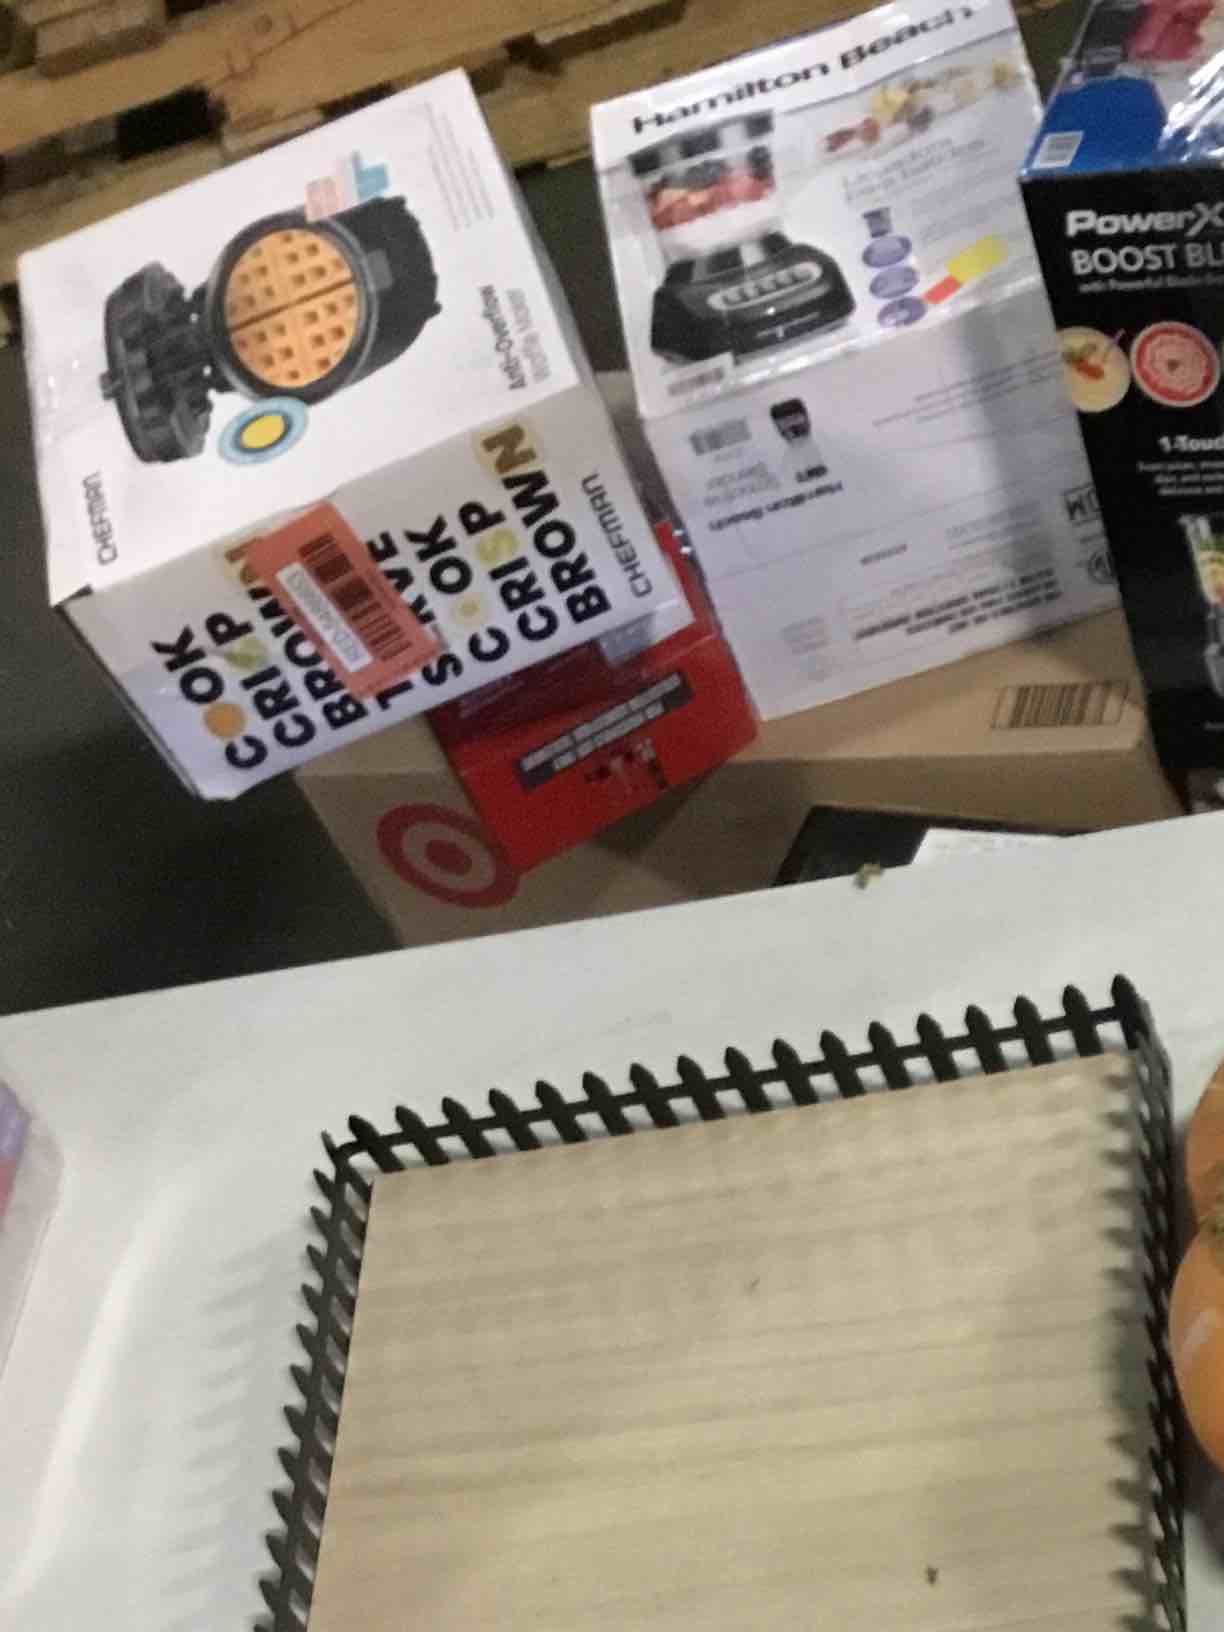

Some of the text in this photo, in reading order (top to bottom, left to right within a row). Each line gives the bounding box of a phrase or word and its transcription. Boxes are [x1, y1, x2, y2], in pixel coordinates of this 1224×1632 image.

[633, 5, 976, 134] Hamilton Beach
[1072, 242, 1177, 275] BOOST
[482, 424, 611, 624] BROWN
[581, 471, 653, 598] CHEFMAN
